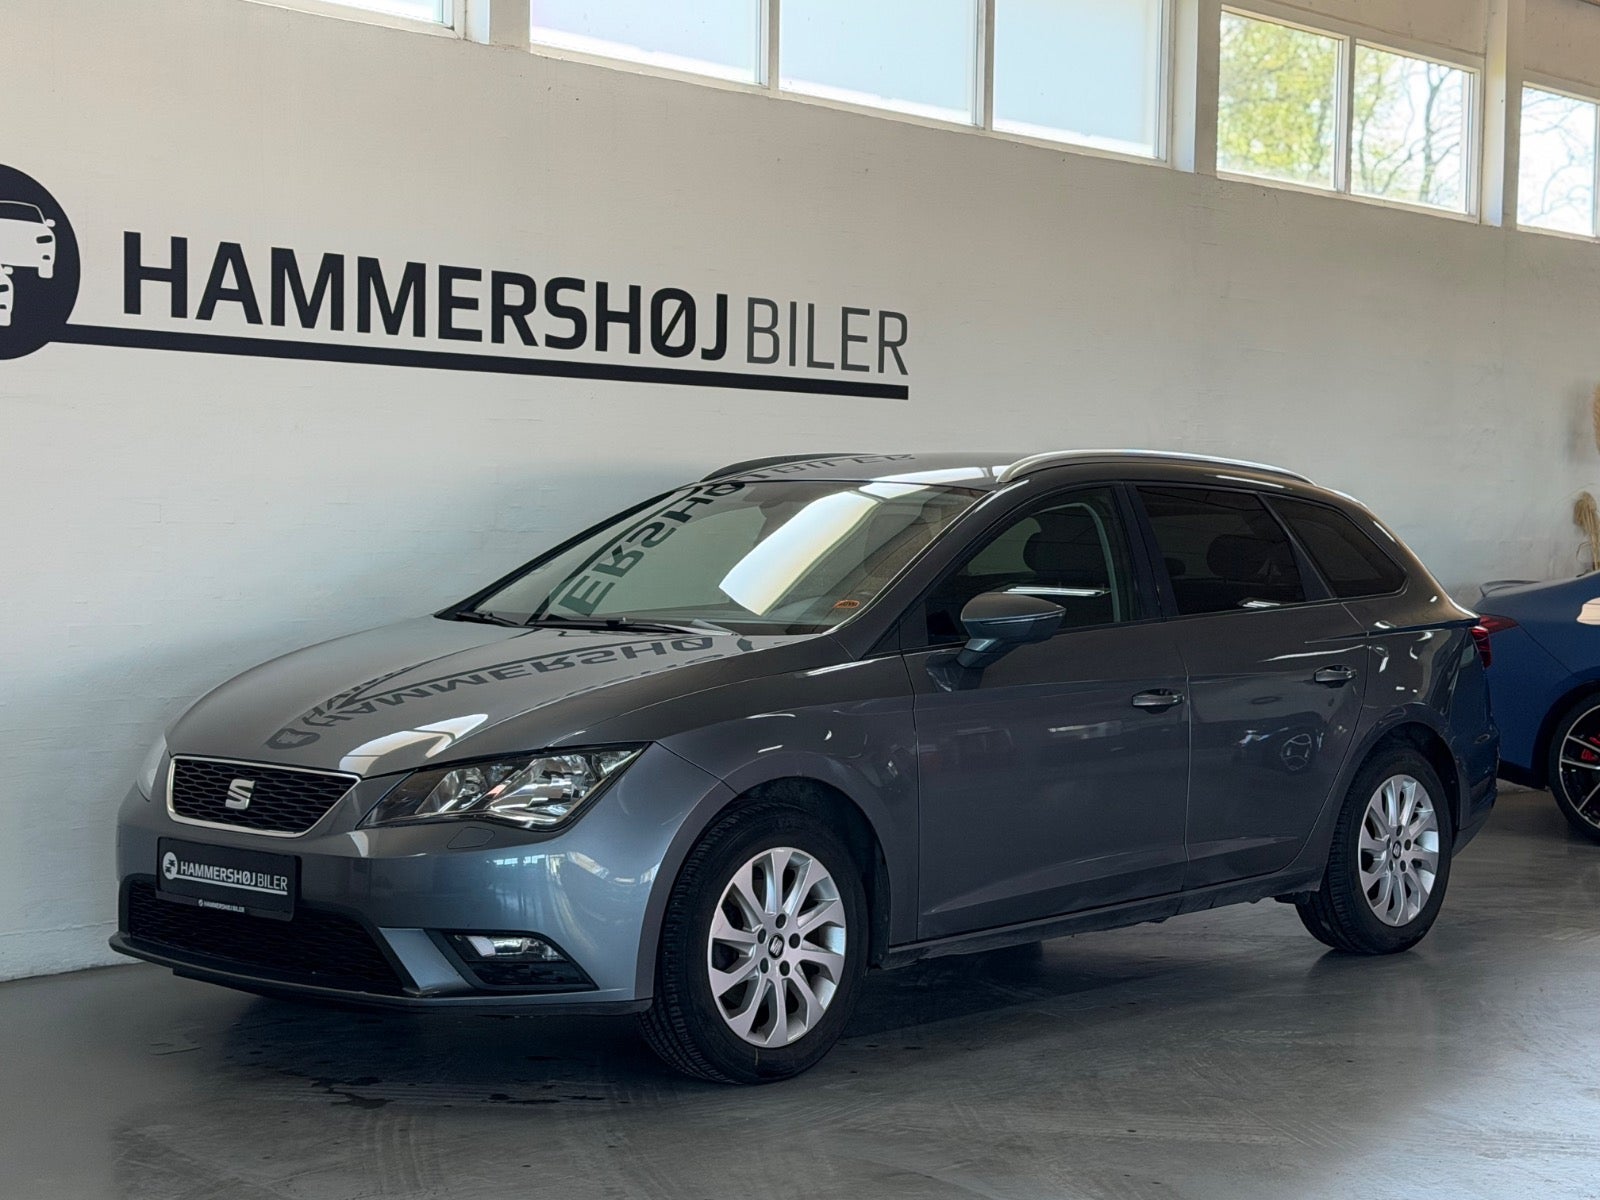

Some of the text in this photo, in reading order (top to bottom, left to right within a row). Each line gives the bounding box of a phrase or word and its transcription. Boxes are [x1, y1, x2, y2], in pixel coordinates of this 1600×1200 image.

[123, 231, 909, 376] HAMMERSHØJ BILER
[180, 861, 287, 890] HAMMERSHØJ BILER
